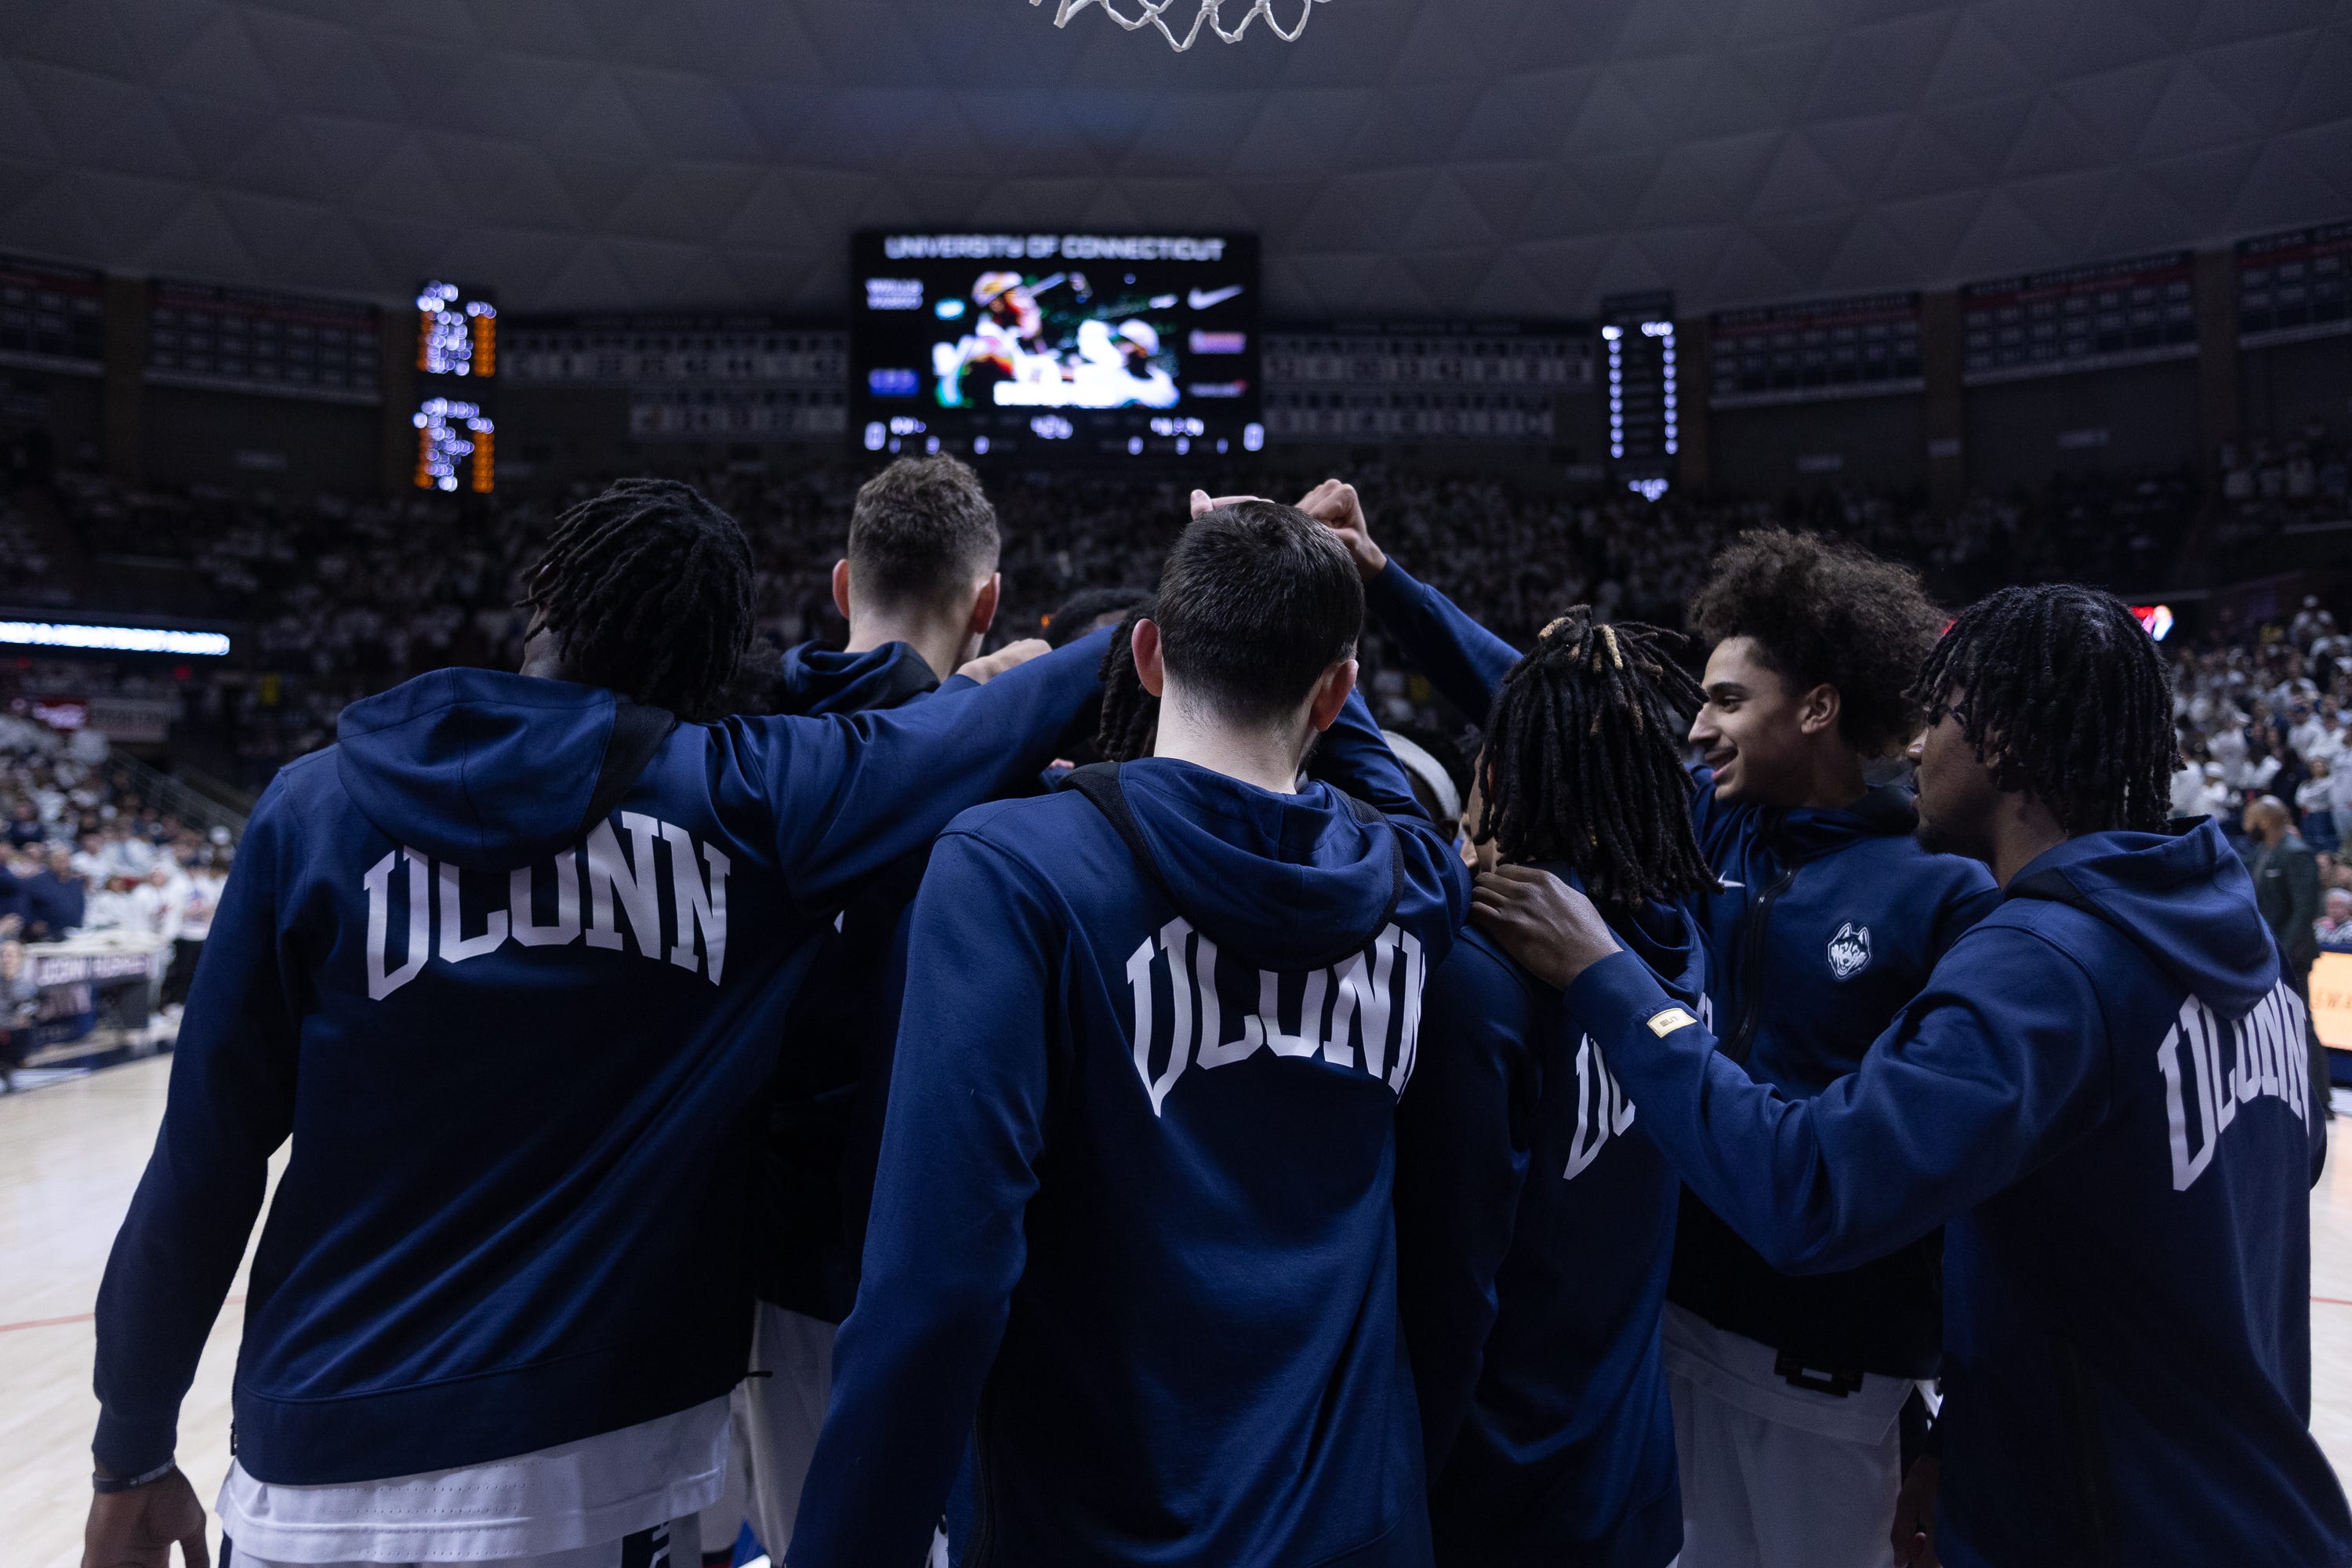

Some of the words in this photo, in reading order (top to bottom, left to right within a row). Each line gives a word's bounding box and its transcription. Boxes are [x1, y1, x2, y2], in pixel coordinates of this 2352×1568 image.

[884, 235, 1020, 259] UNIVERSITY
[1025, 236, 1059, 258] OF
[1062, 237, 1226, 260] CONNECTICUT
